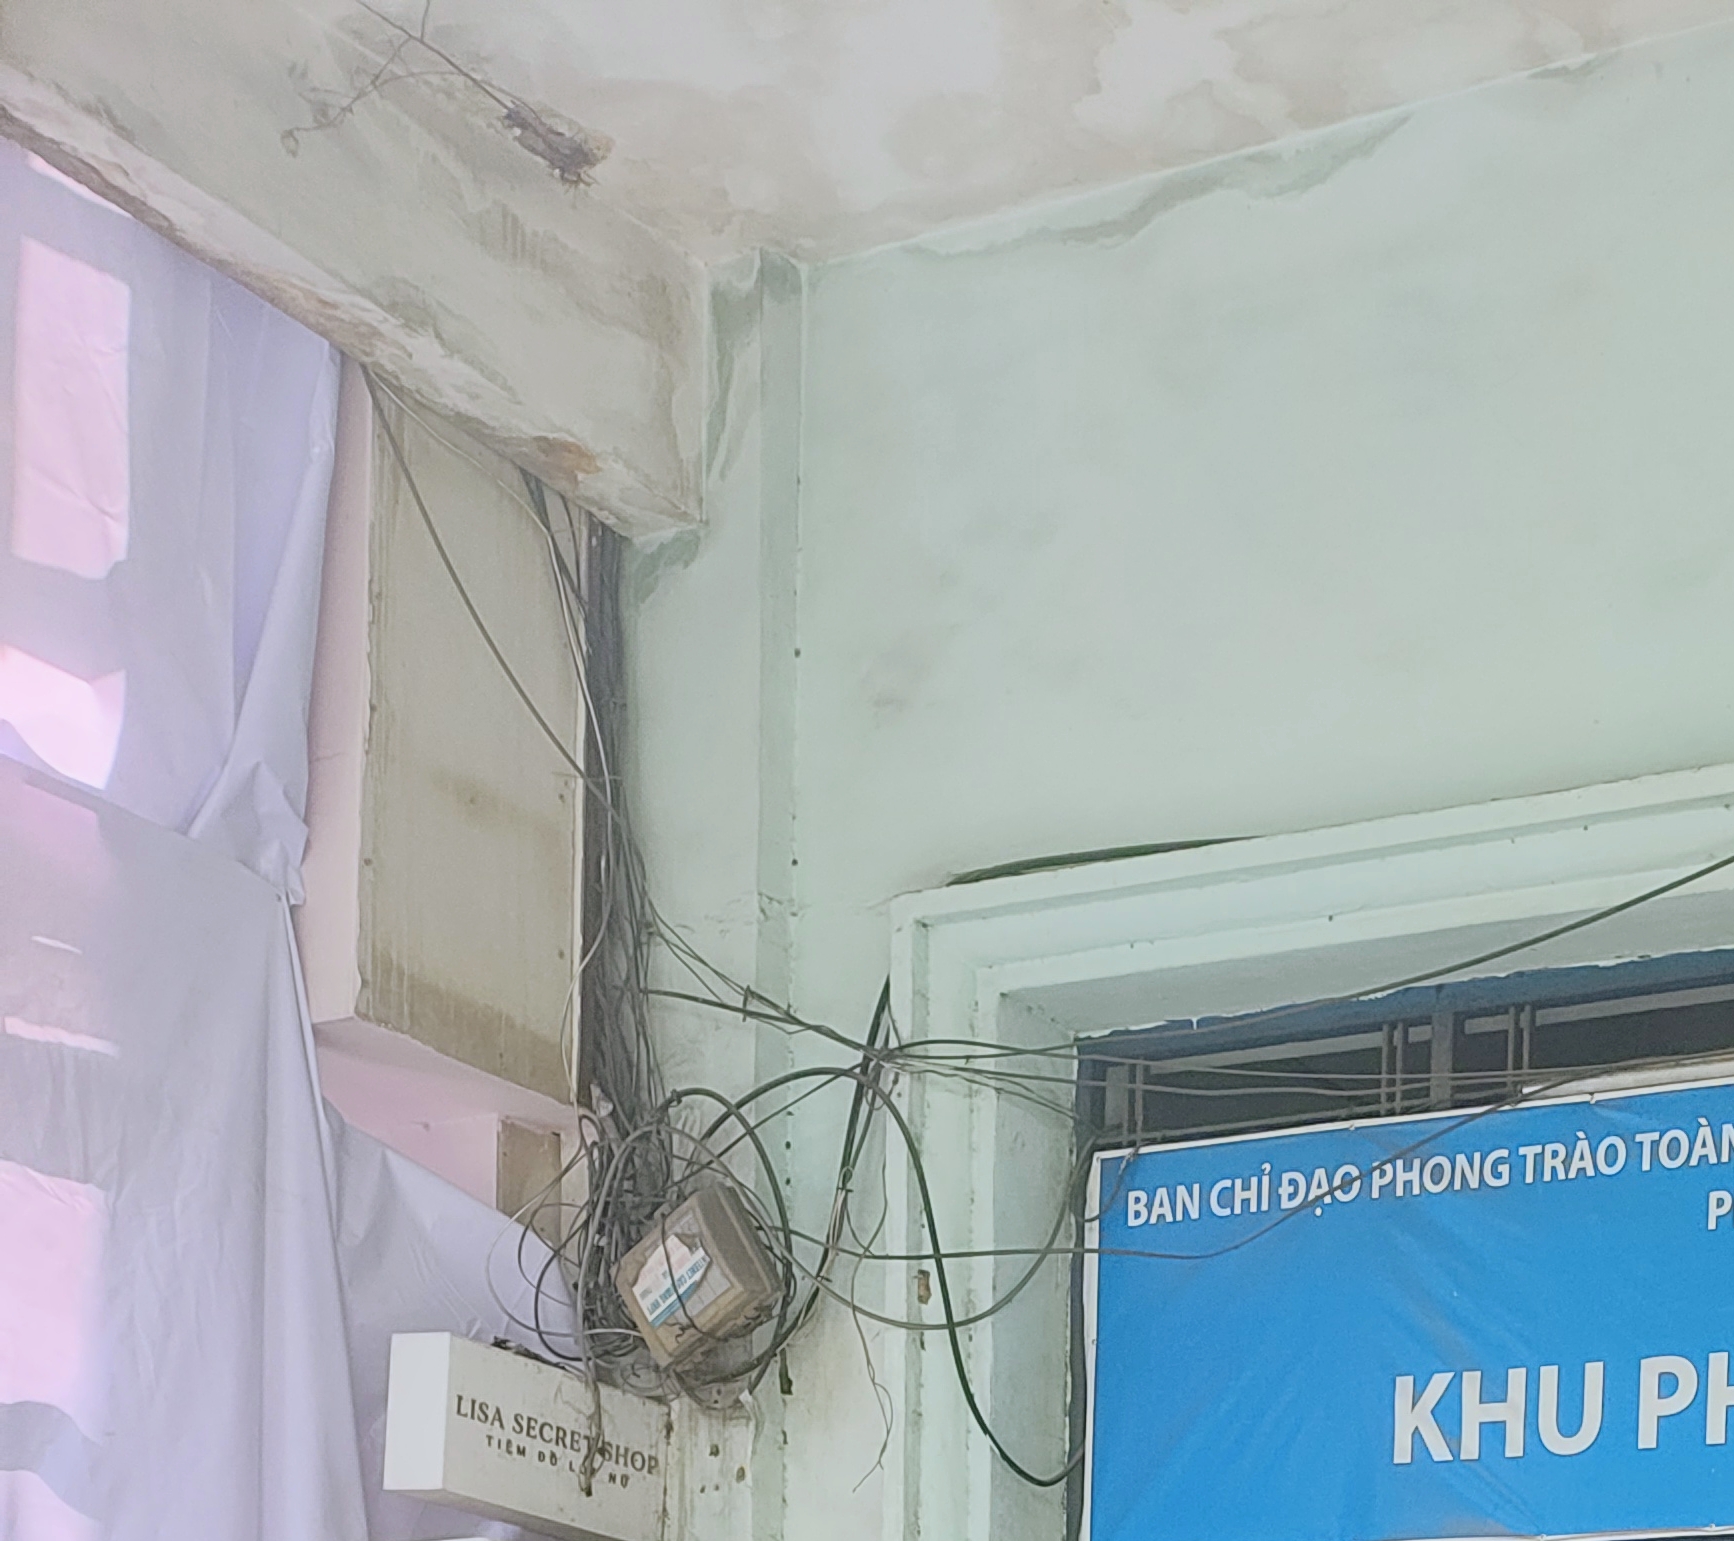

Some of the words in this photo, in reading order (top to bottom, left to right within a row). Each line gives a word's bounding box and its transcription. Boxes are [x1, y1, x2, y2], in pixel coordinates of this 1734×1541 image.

[1126, 1182, 1200, 1228] BAN
[1209, 1163, 1273, 1221] CHỈ
[1278, 1163, 1362, 1217] ĐẠO
[1371, 1148, 1510, 1203] PHONG
[1520, 1130, 1628, 1185] TRÀO
[455, 1393, 506, 1432] LISA
[511, 1413, 595, 1456] SECRET
[603, 1440, 660, 1476] SHOP
[1393, 1358, 1605, 1467] KHU
